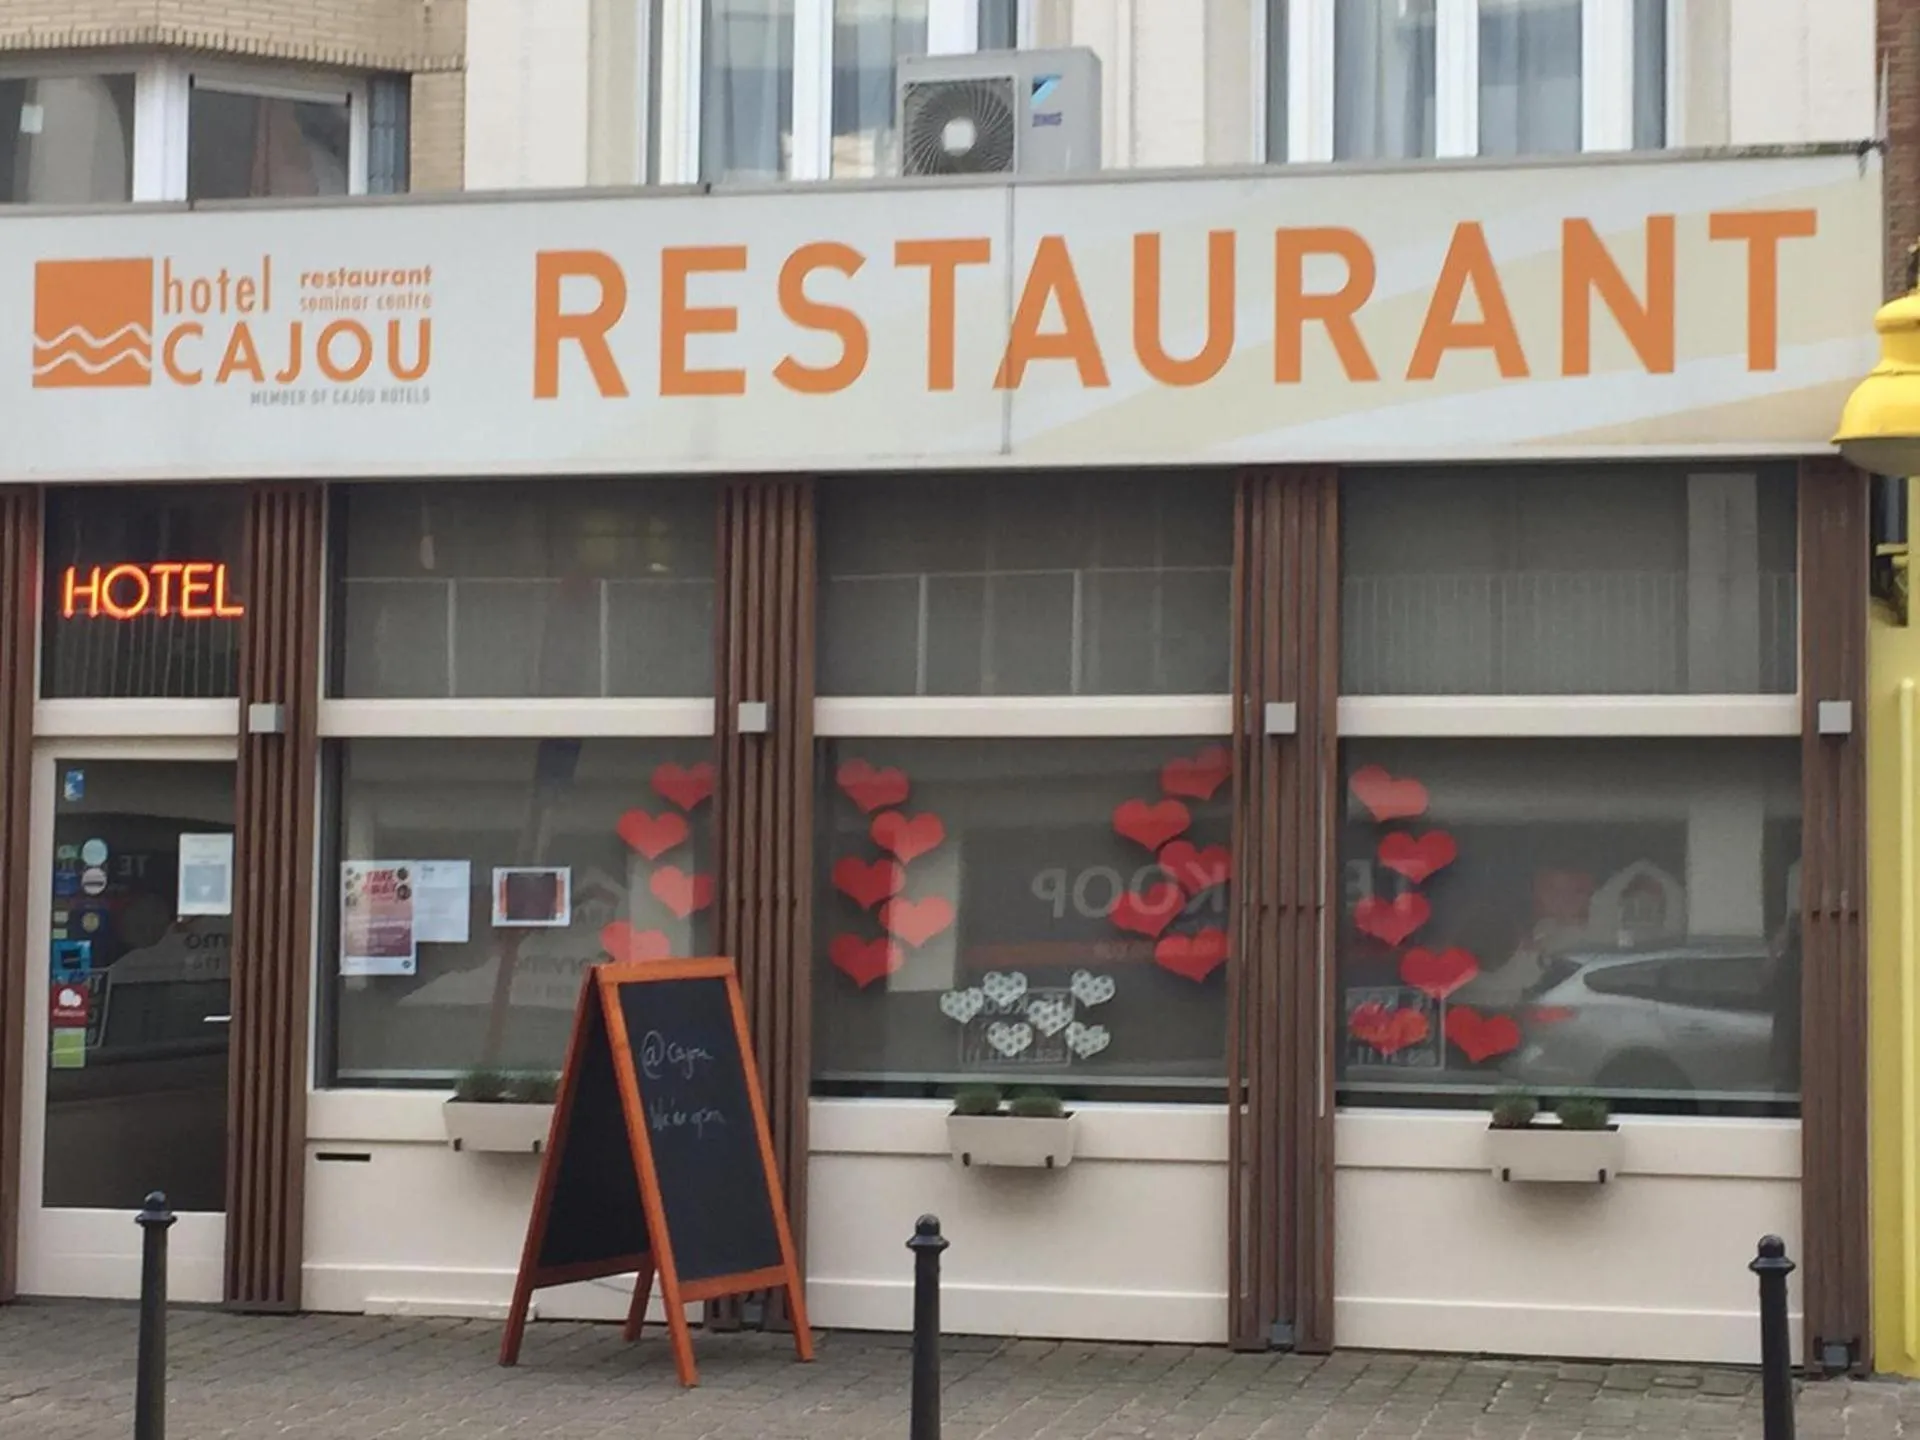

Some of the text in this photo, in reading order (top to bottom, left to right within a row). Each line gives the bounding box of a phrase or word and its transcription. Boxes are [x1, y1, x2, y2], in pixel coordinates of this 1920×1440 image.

[163, 254, 271, 315] hotel
[300, 265, 433, 289] restaurant
[533, 208, 1818, 399] RESTAURANT
[162, 317, 432, 387] CAJOU
[63, 562, 245, 619] HOTEL
